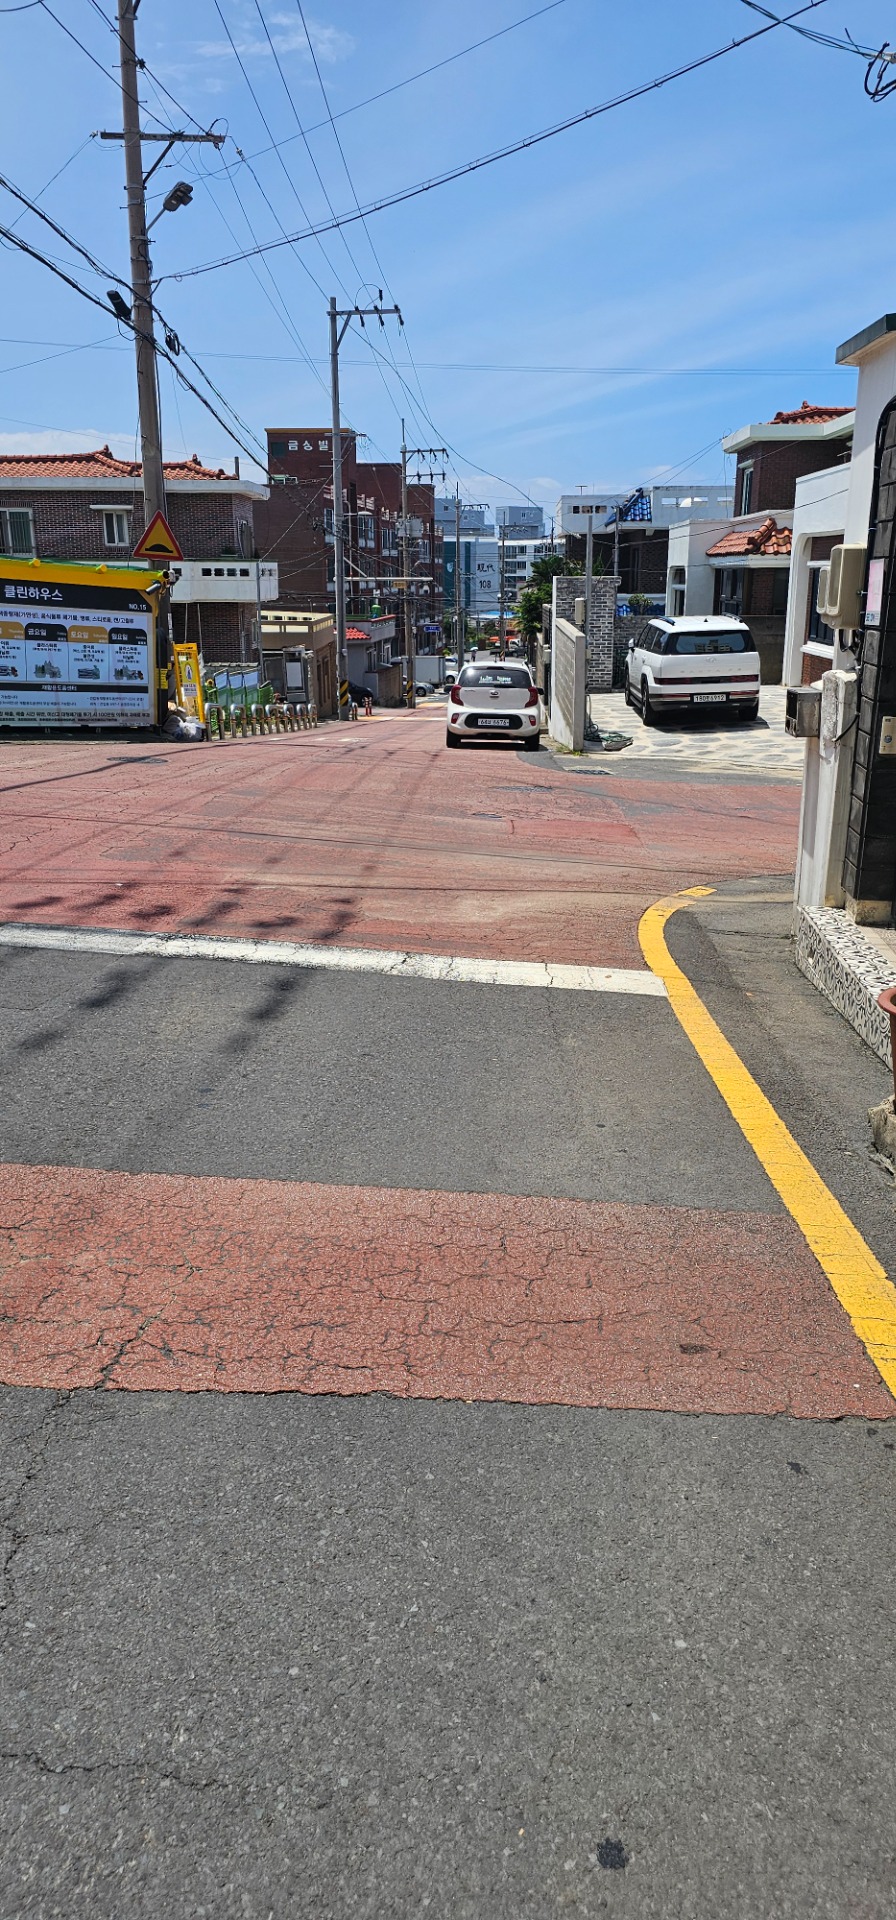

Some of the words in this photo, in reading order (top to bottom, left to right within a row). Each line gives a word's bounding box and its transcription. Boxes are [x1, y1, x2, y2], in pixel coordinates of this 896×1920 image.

[479, 580, 492, 589] 108
[4, 585, 64, 601] 클린하우스
[128, 603, 147, 611] NO.15
[27, 628, 47, 636] 금요일
[70, 631, 89, 639] 토요일
[111, 633, 128, 641] 일요일
